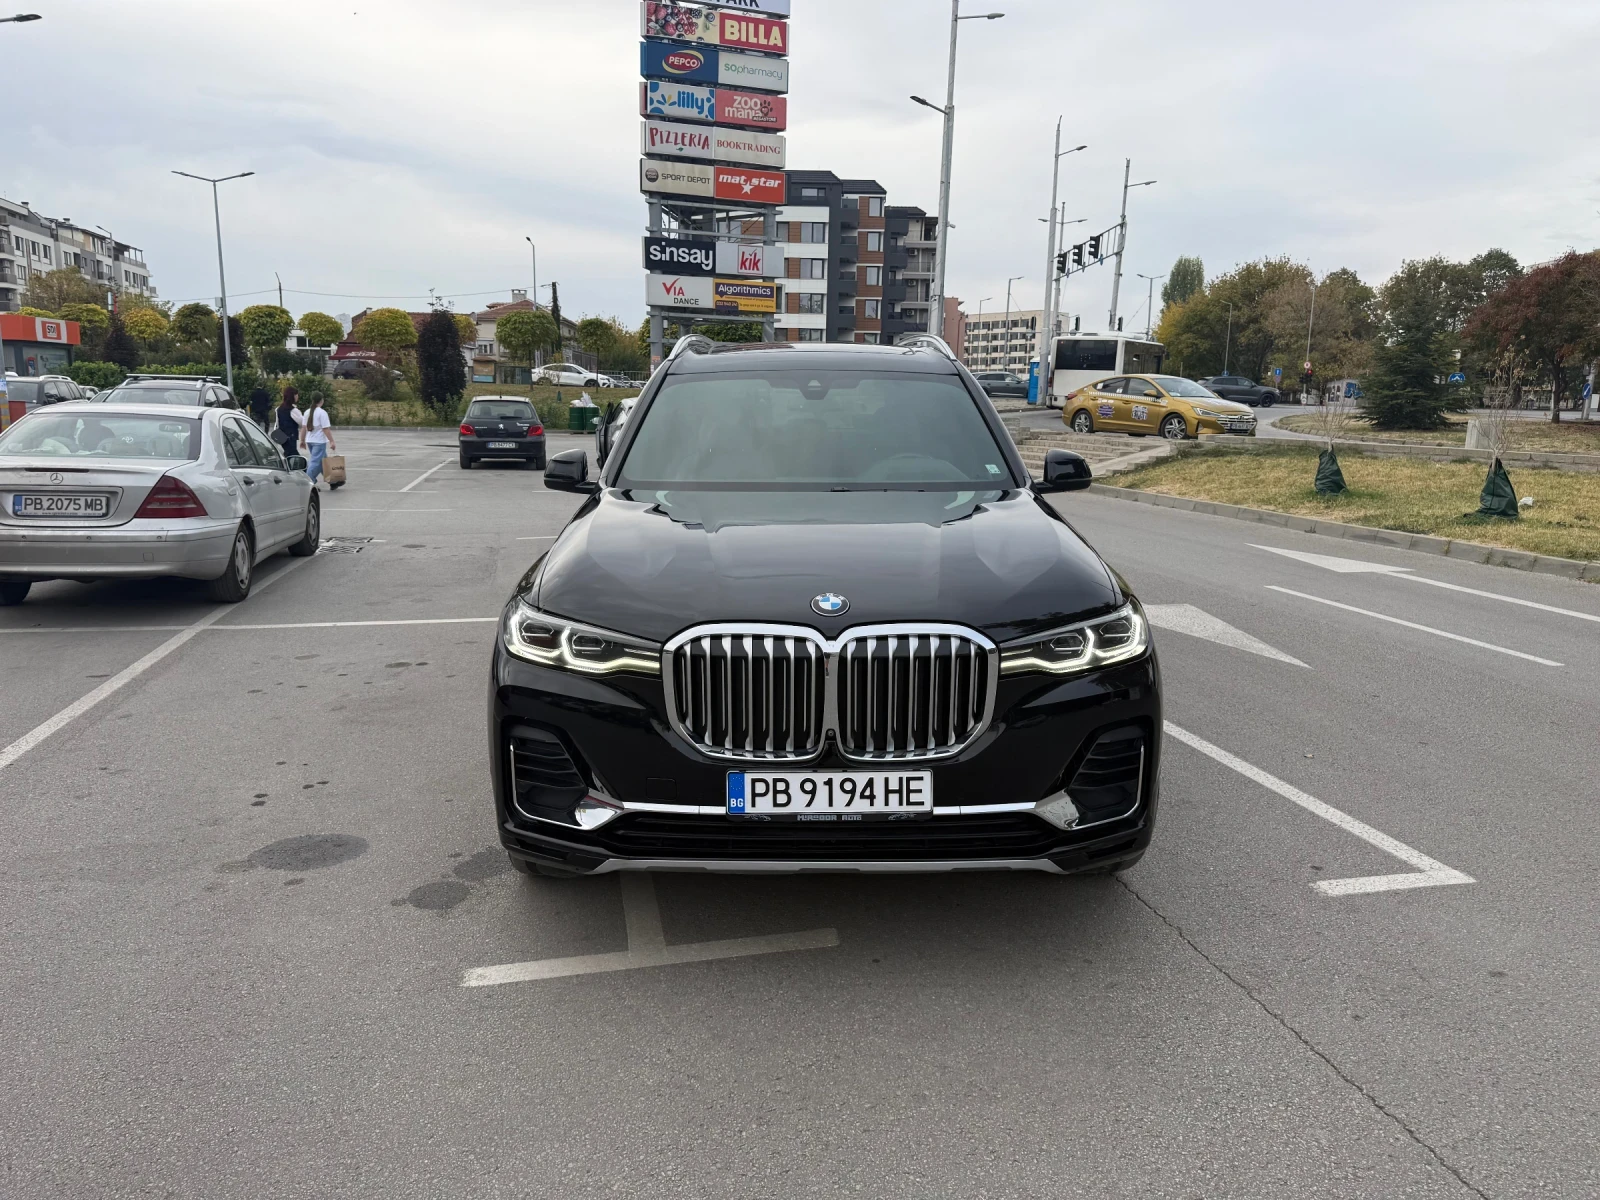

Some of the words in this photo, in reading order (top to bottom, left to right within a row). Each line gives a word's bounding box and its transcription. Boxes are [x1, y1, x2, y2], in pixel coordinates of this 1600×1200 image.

[724, 19, 783, 47] BILLA
[668, 55, 698, 68] PEPCO
[724, 63, 783, 80] sopharmacy
[677, 90, 705, 114] lilly
[724, 106, 763, 119] mania
[649, 127, 710, 150] PIZZERIA
[716, 139, 781, 155] BOOKTRADING
[661, 173, 686, 181] SPORT
[687, 175, 711, 184] DEPOT
[718, 173, 747, 185] mat
[751, 177, 782, 188] star
[650, 241, 713, 271] sinsay
[739, 249, 762, 272] kik
[718, 284, 771, 295] Algorithmics
[673, 297, 700, 305] DANCE
[24, 498, 43, 511] PB
[46, 498, 81, 511] 2075
[84, 498, 103, 511] MB
[750, 777, 792, 808] PB
[799, 776, 876, 808] 9194
[884, 776, 925, 807] HE
[730, 798, 744, 808] BG
